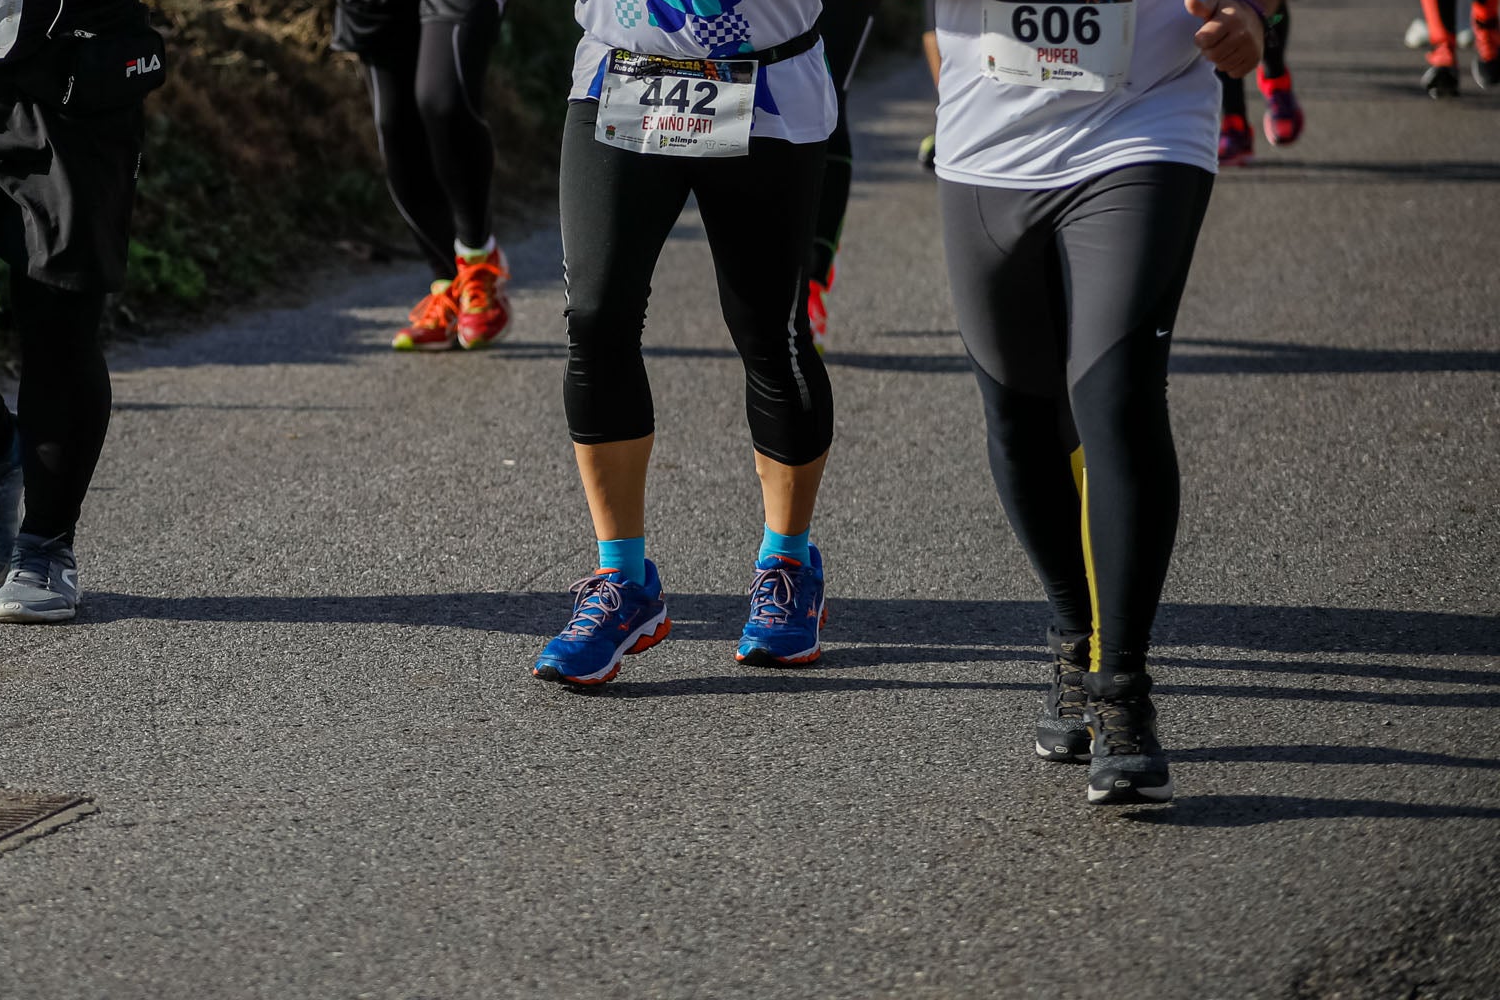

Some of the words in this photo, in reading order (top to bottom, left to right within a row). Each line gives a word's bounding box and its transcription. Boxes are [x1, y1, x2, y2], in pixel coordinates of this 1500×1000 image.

[1012, 5, 1100, 45] 606
[615, 49, 632, 61] 26
[1037, 47, 1078, 64] PUPER
[125, 54, 161, 78] FILA
[613, 63, 627, 72] Ruta
[639, 77, 718, 116] 442
[657, 113, 684, 131] NIÑO
[687, 117, 713, 134] PATI
[670, 135, 698, 145] olimpo
